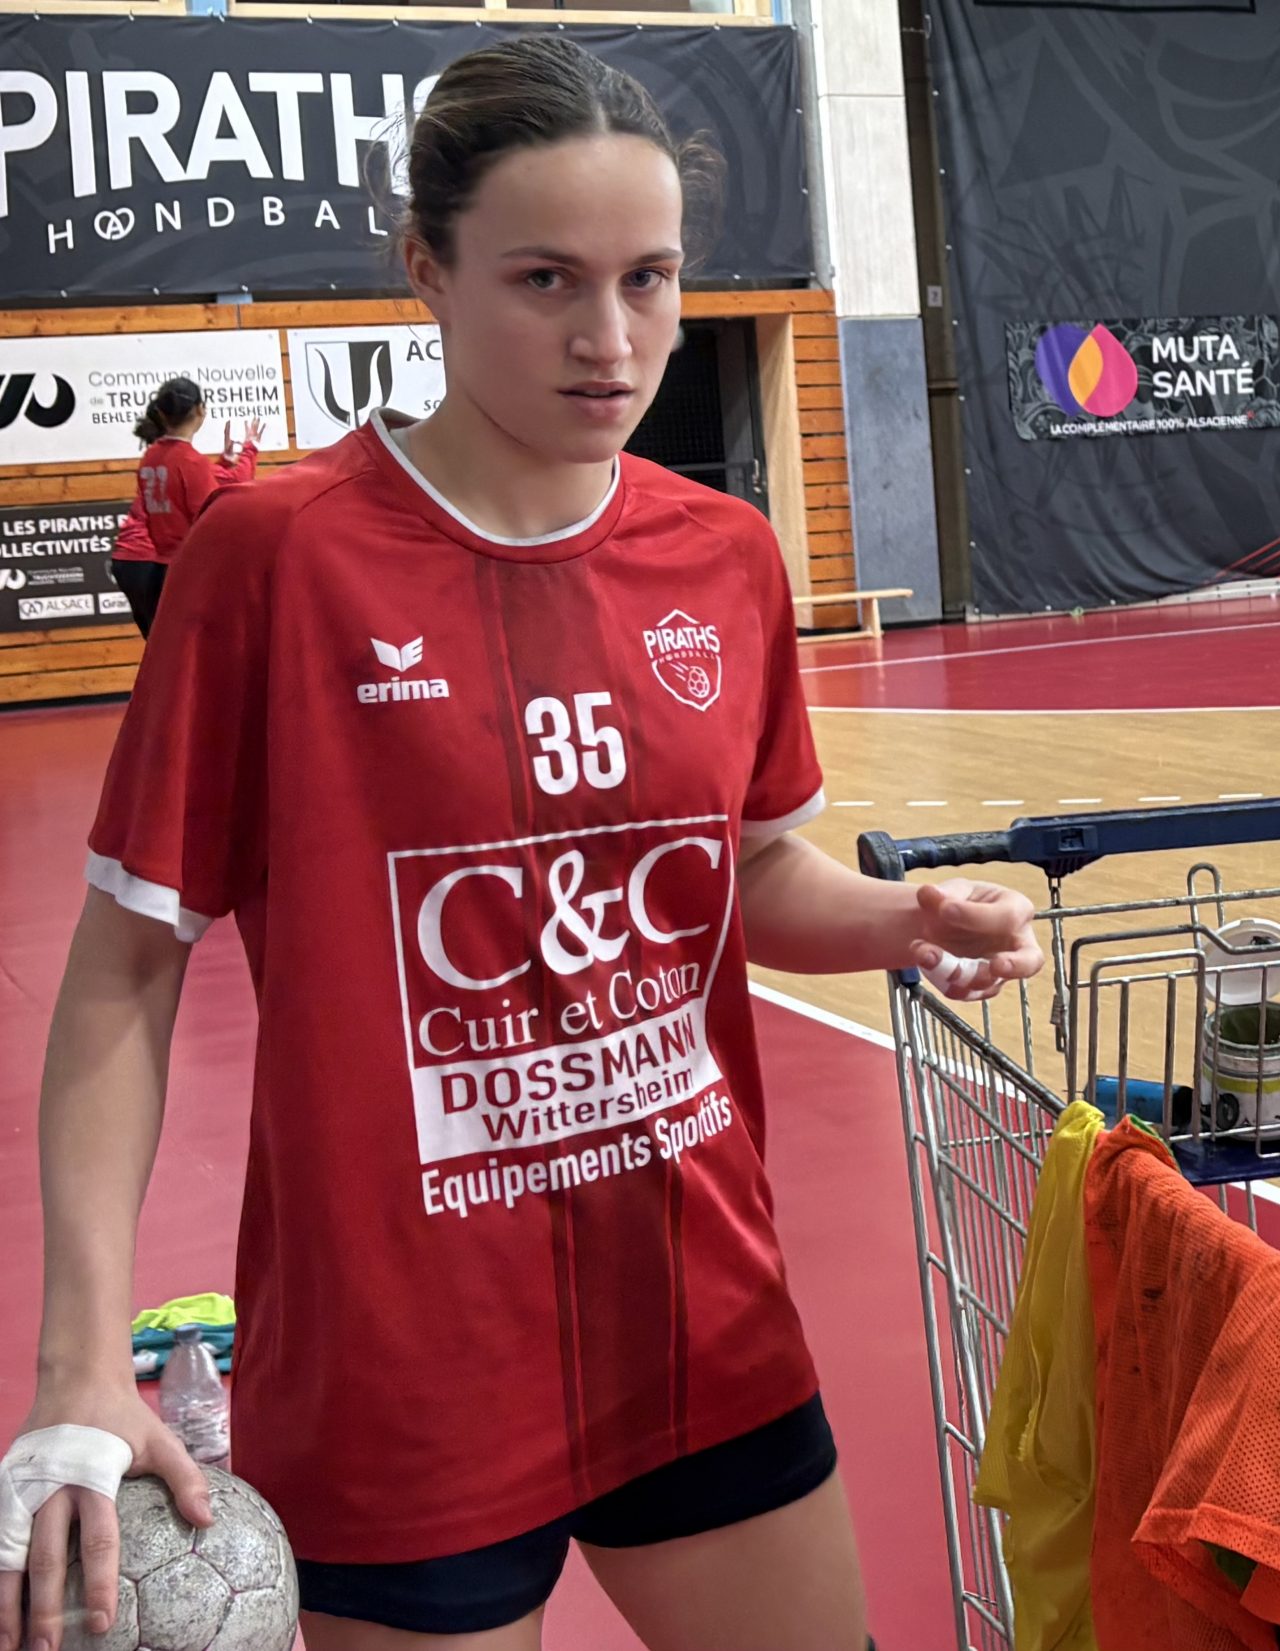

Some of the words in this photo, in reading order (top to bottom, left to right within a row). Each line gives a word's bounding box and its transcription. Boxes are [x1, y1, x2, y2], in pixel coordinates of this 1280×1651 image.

[0, 70, 441, 217] PIRATH
[48, 196, 388, 254] HANDBAL
[406, 339, 443, 361] AC
[1152, 334, 1240, 363] MUTA
[197, 365, 277, 383] Nouvelle
[1152, 361, 1254, 398] SANTÉ
[210, 405, 280, 419] ETTISHEIM
[1156, 418, 1185, 430] 100%
[1186, 415, 1248, 428] ALSACIENNE
[3, 520, 36, 536] LES
[39, 514, 115, 534] PIRATHS
[0, 534, 112, 558] LLECTIVITÉS
[642, 625, 721, 659] PIRATHS
[357, 676, 450, 703] erima
[523, 691, 627, 796] 35
[417, 837, 723, 990] C&C
[419, 999, 539, 1057] Cuir
[560, 990, 603, 1036] et
[608, 961, 702, 1020] Coton
[440, 1012, 696, 1115] DOSSMANN
[482, 1067, 695, 1143] Wittersheim
[421, 1131, 652, 1218] Equipements
[654, 1092, 733, 1164] Sportifs
